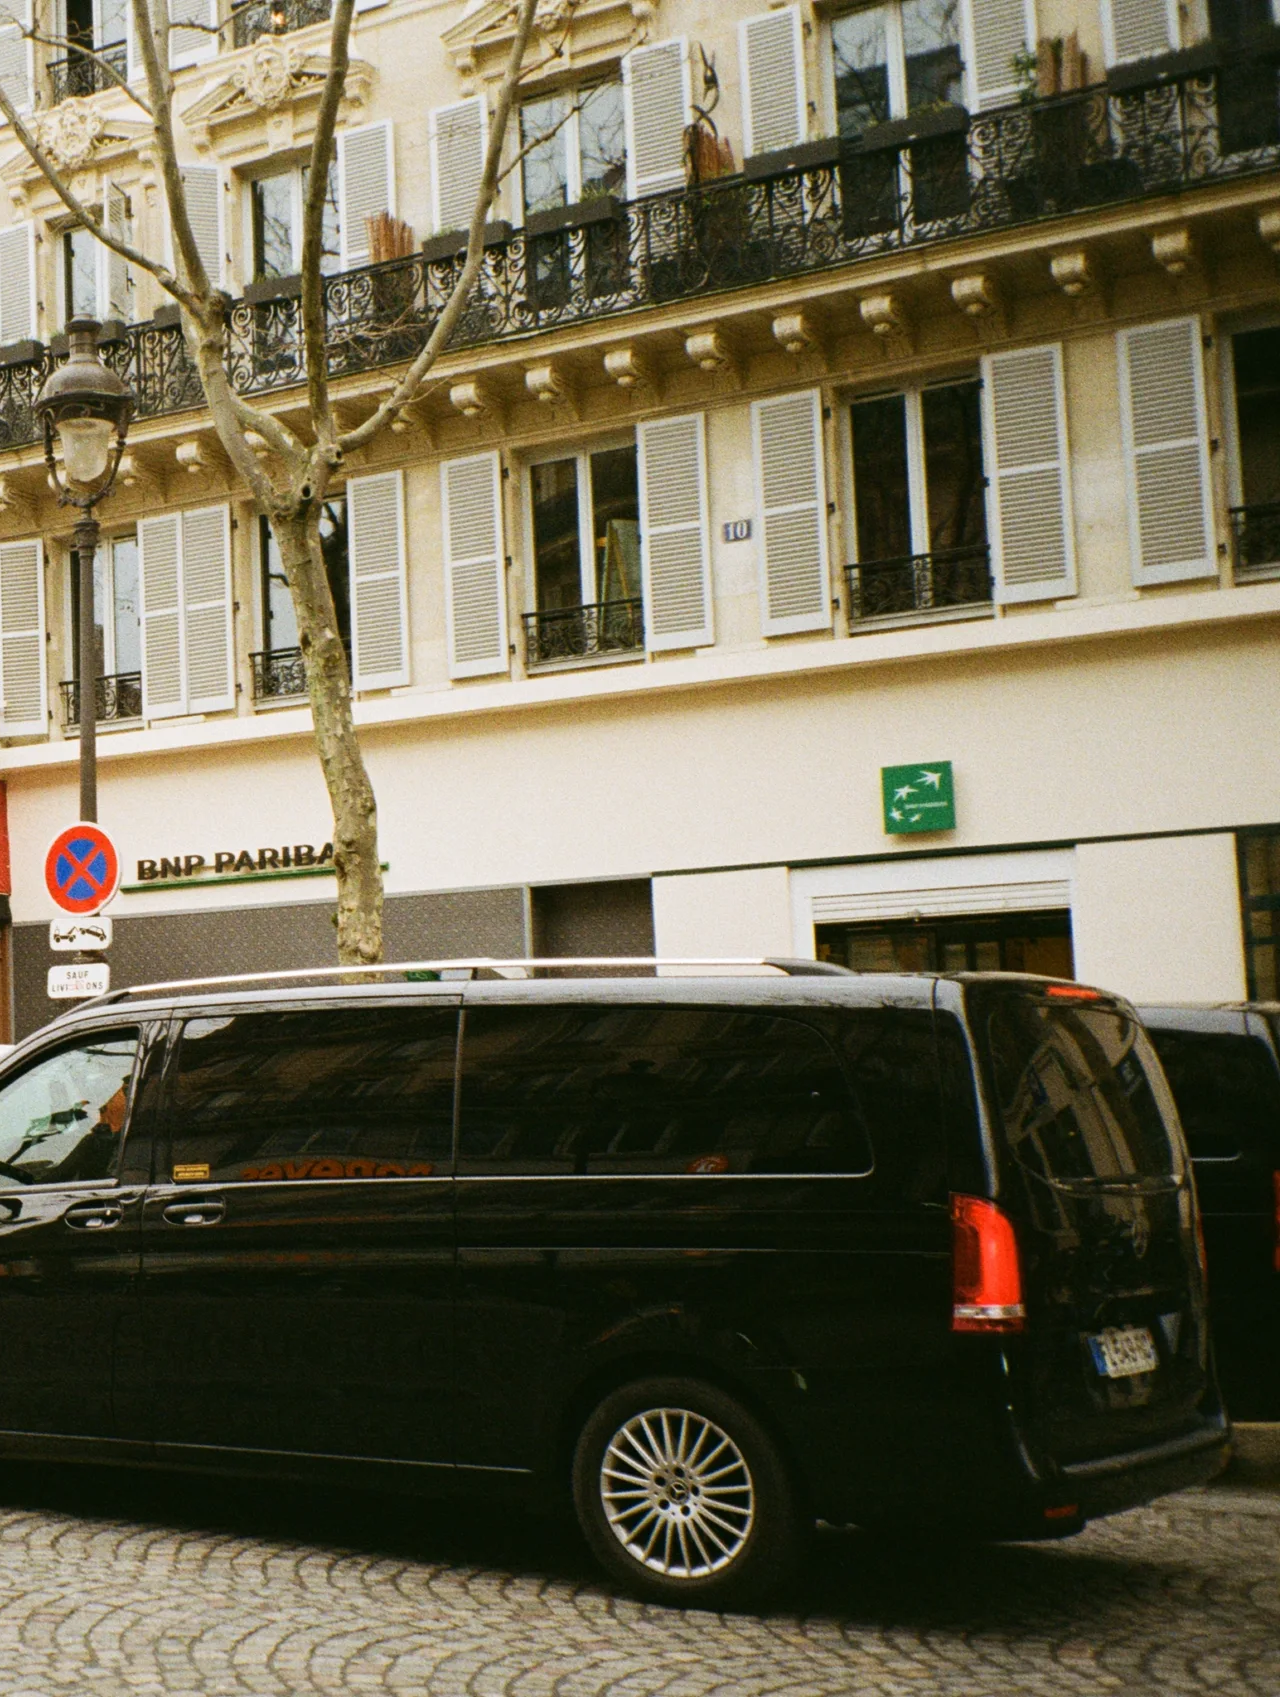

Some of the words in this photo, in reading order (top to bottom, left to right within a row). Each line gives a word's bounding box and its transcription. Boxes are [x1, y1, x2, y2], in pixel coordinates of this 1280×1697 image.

[726, 521, 748, 541] 10
[137, 854, 205, 881] BNP
[215, 842, 334, 873] PARIBA
[66, 971, 89, 980] SAUF
